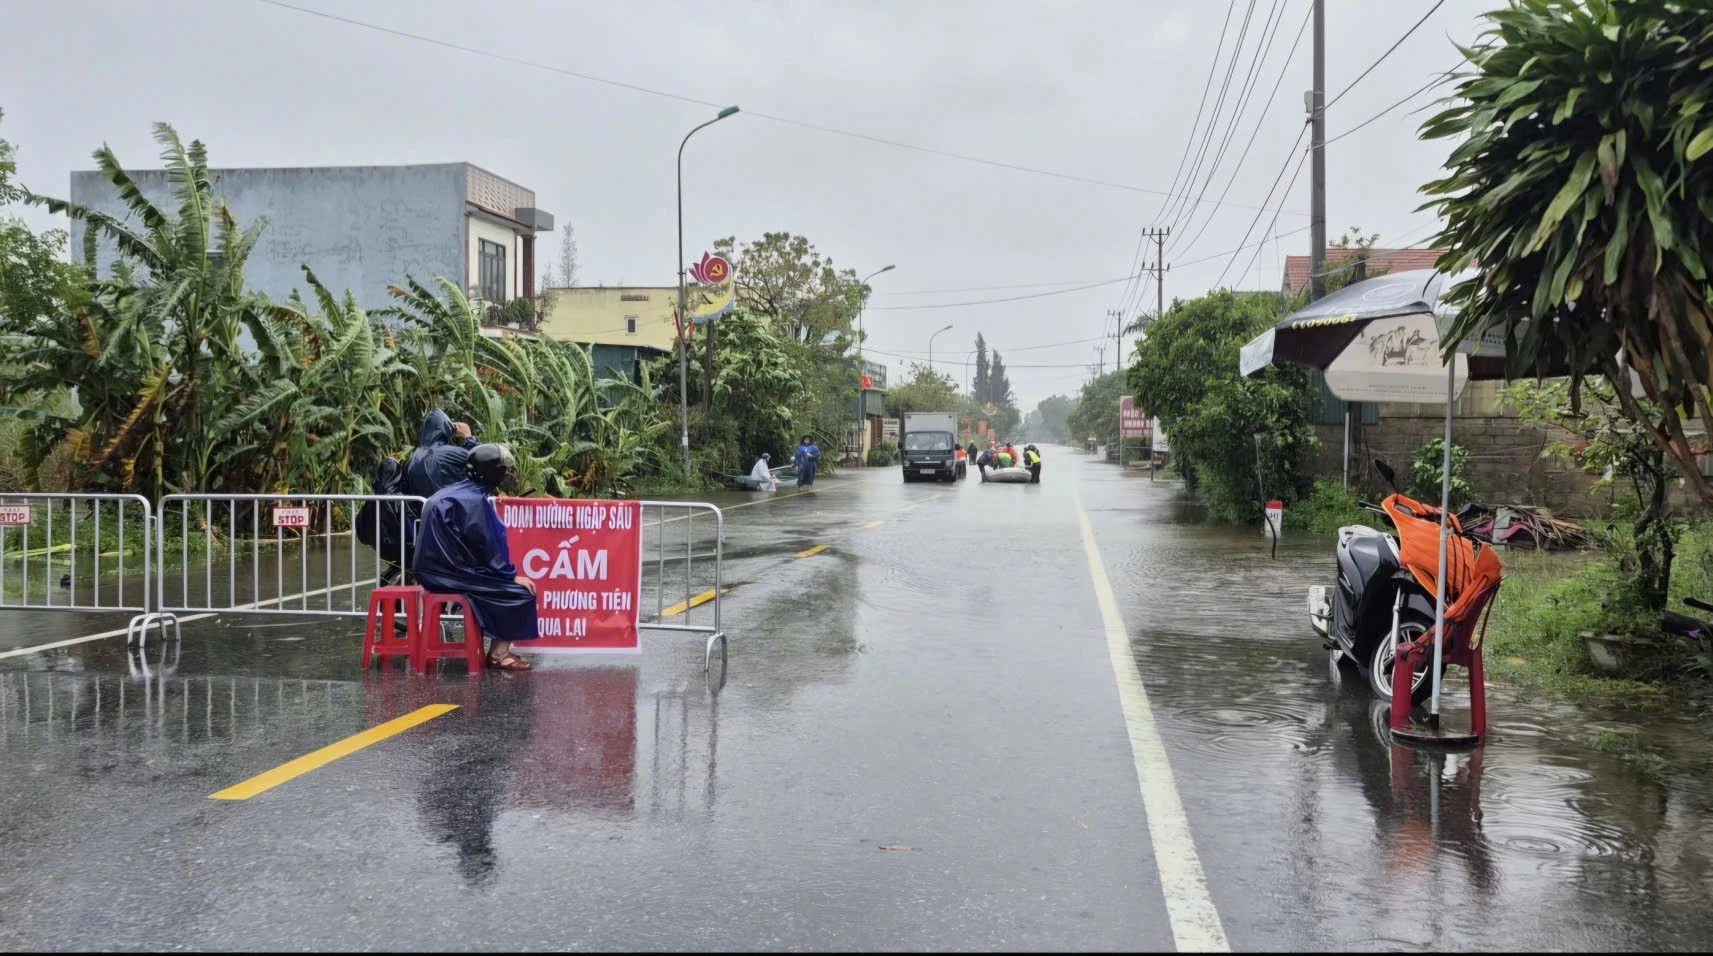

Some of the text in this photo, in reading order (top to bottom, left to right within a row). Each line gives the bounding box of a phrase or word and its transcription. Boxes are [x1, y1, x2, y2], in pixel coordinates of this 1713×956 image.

[0, 512, 25, 521] STOP
[279, 515, 304, 524] STOP
[576, 502, 606, 534] NGẬP
[609, 502, 632, 529] SÂU
[522, 535, 608, 580] CẤM
[543, 588, 631, 614] PHƯƠNG TIỆN
[537, 617, 587, 640] QUA LẠI
